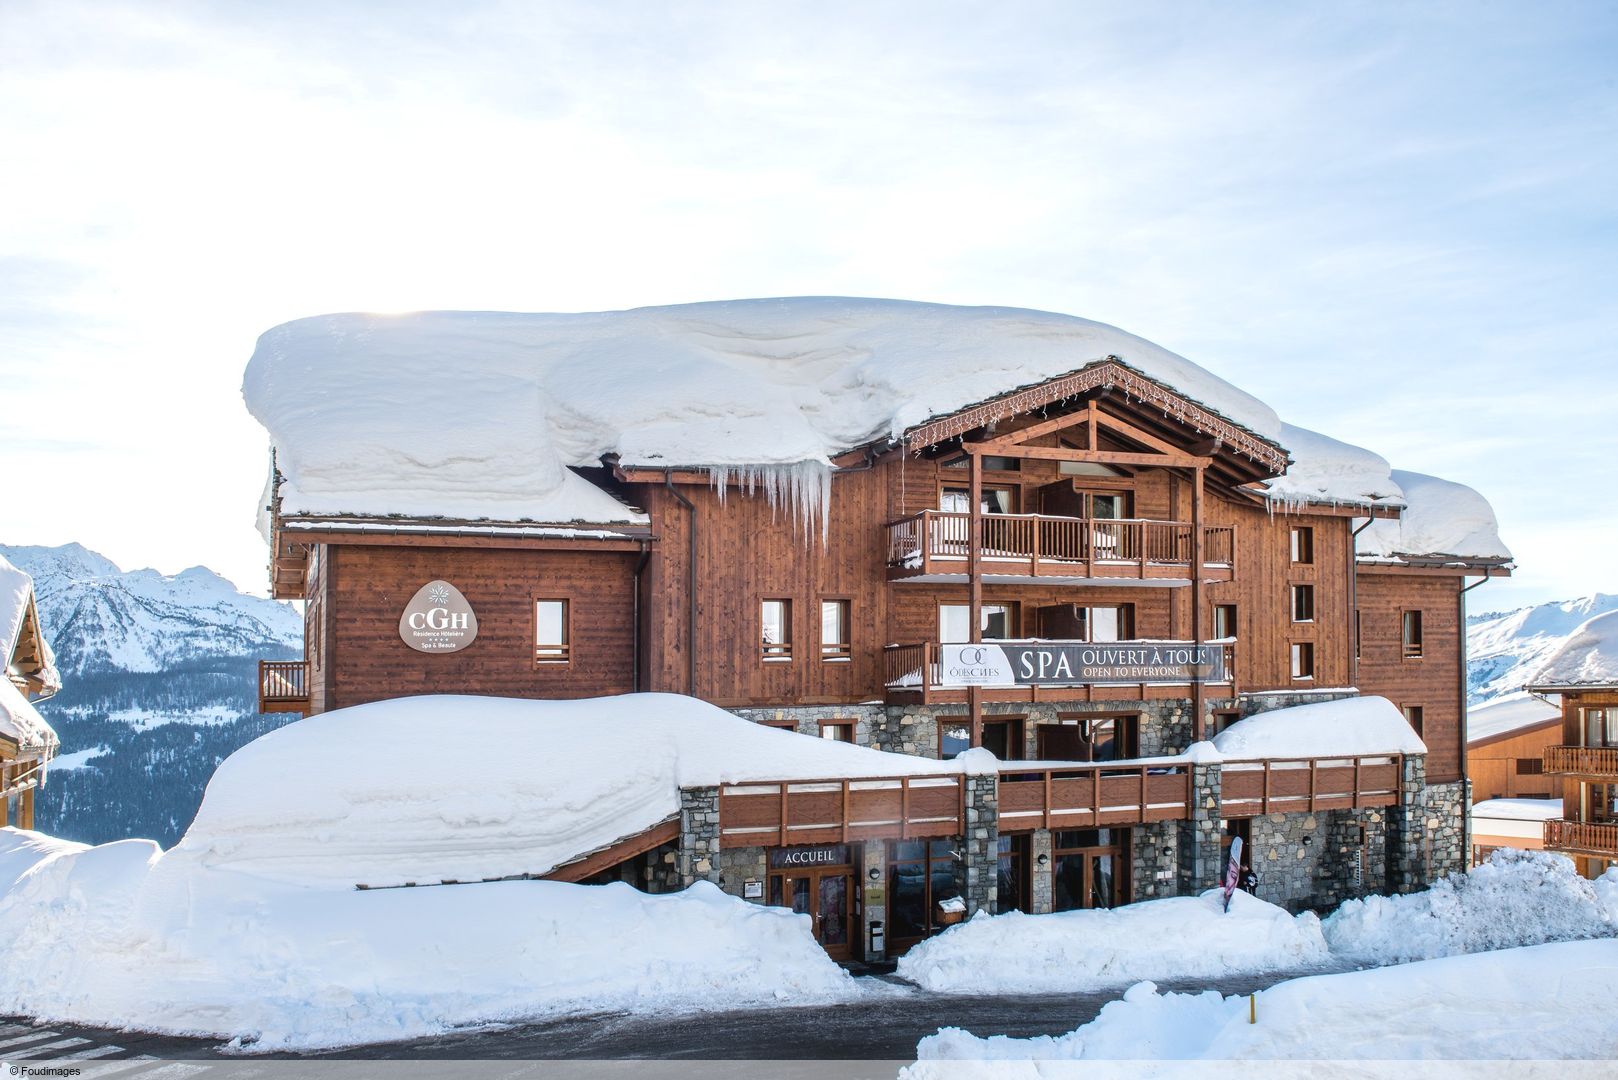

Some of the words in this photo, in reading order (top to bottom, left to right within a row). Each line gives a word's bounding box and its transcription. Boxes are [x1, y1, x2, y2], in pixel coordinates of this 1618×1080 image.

[408, 607, 468, 630] CGH
[1020, 651, 1075, 679] SPA
[1082, 650, 1148, 665] OUVERT
[1151, 646, 1163, 665] À
[1083, 667, 1111, 677] OPEN
[1114, 667, 1129, 677] TO
[1132, 667, 1181, 677] EVERYONE
[784, 850, 834, 864] ACCUEIL
